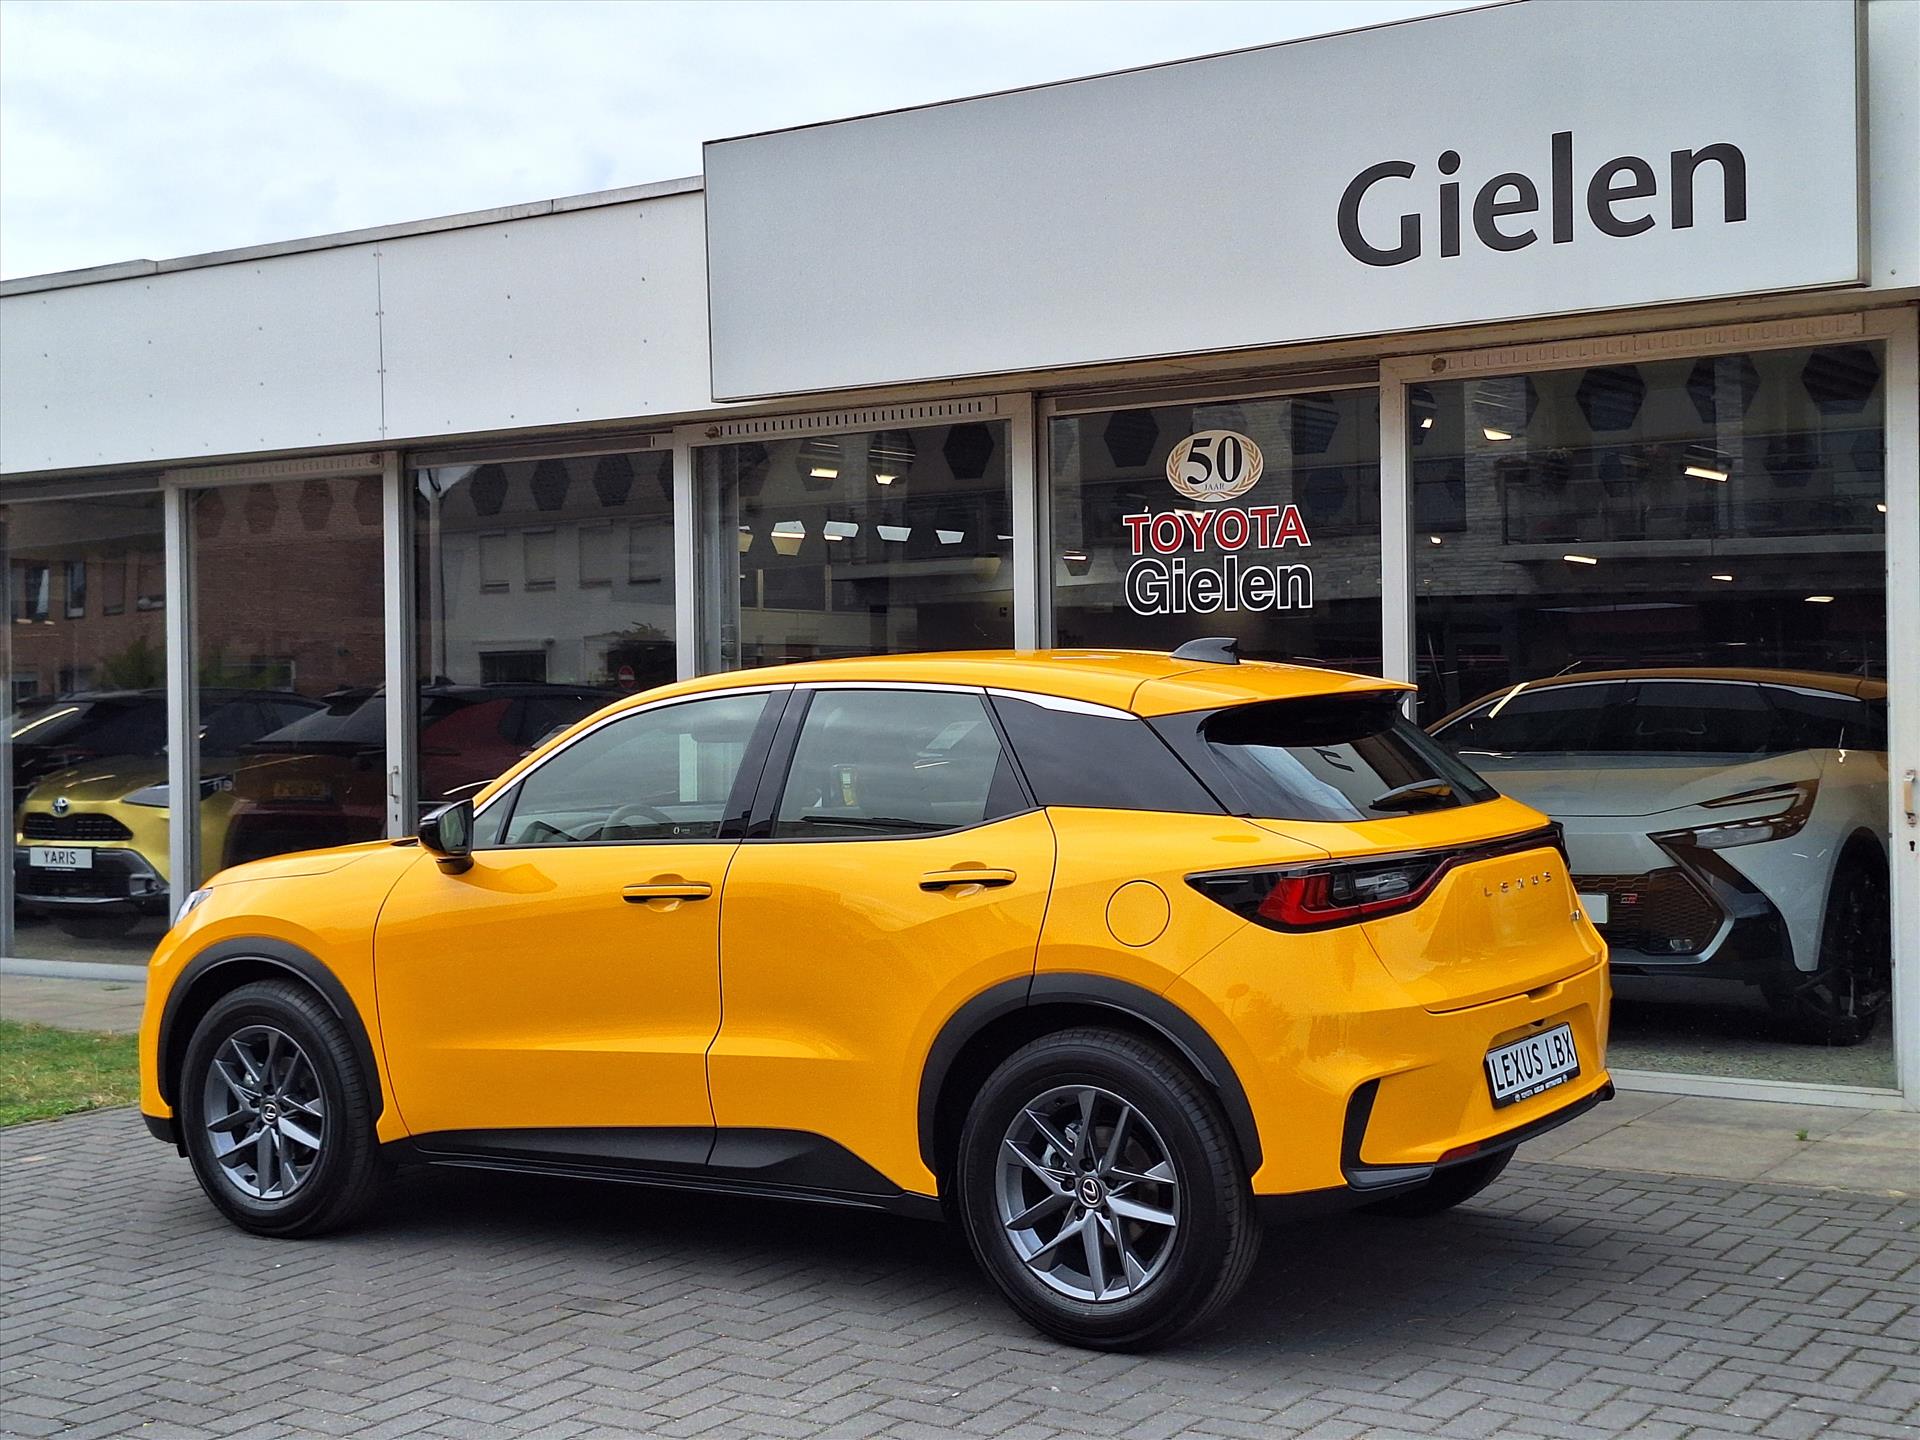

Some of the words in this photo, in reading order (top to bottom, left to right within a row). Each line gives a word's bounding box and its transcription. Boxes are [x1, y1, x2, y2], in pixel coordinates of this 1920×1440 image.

[1337, 130, 1746, 268] Gielen
[1187, 435, 1243, 484] 50
[1204, 482, 1225, 491] JAAR
[1123, 504, 1311, 555] TOYOTA
[1125, 555, 1313, 616] Gielen
[44, 851, 76, 865] YARIS
[1484, 871, 1552, 896] LEXUS
[1492, 1043, 1544, 1090] LEXUS
[1545, 1031, 1575, 1069] LBX
